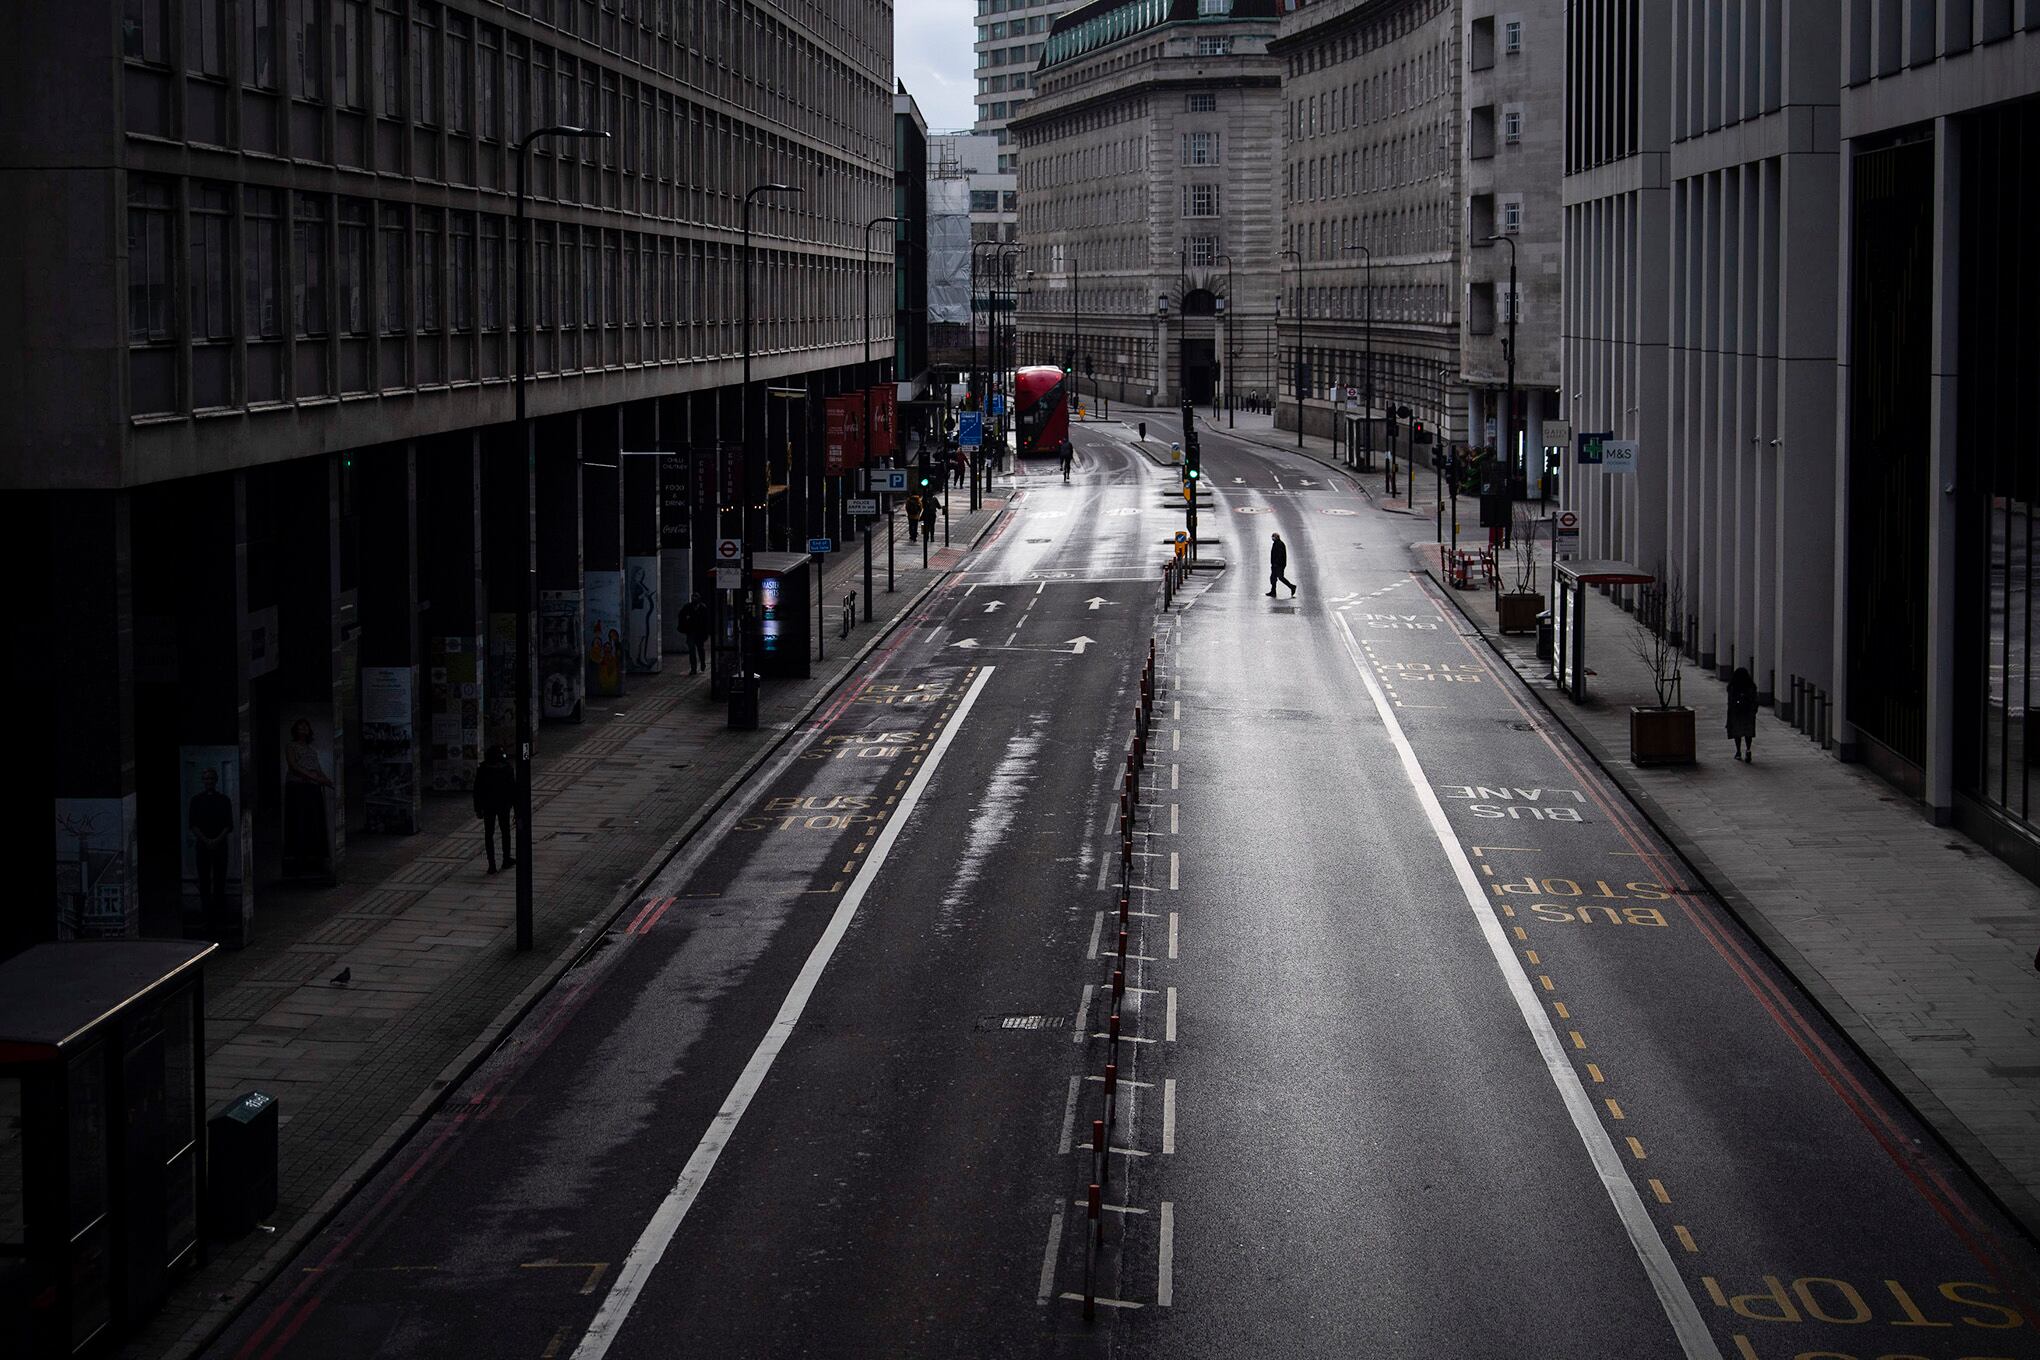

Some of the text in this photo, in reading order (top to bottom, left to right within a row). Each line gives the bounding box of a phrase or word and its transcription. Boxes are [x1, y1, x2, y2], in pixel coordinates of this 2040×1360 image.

[1606, 448, 1632, 459] M&S
[892, 475, 902, 487] P
[1352, 613, 1444, 622] LANE
[1367, 621, 1438, 630] BUS
[1381, 662, 1486, 673] STOP
[1400, 672, 1481, 682] BUS
[822, 732, 921, 745] BUS
[800, 745, 919, 759] STOP
[1440, 785, 1587, 803] LANE
[763, 796, 878, 811] BUS
[1469, 804, 1584, 822] BUS
[734, 815, 877, 831] STOP
[1502, 877, 1671, 900] STOP
[1531, 903, 1669, 927] BUS
[1729, 1275, 2025, 1329] STOP
